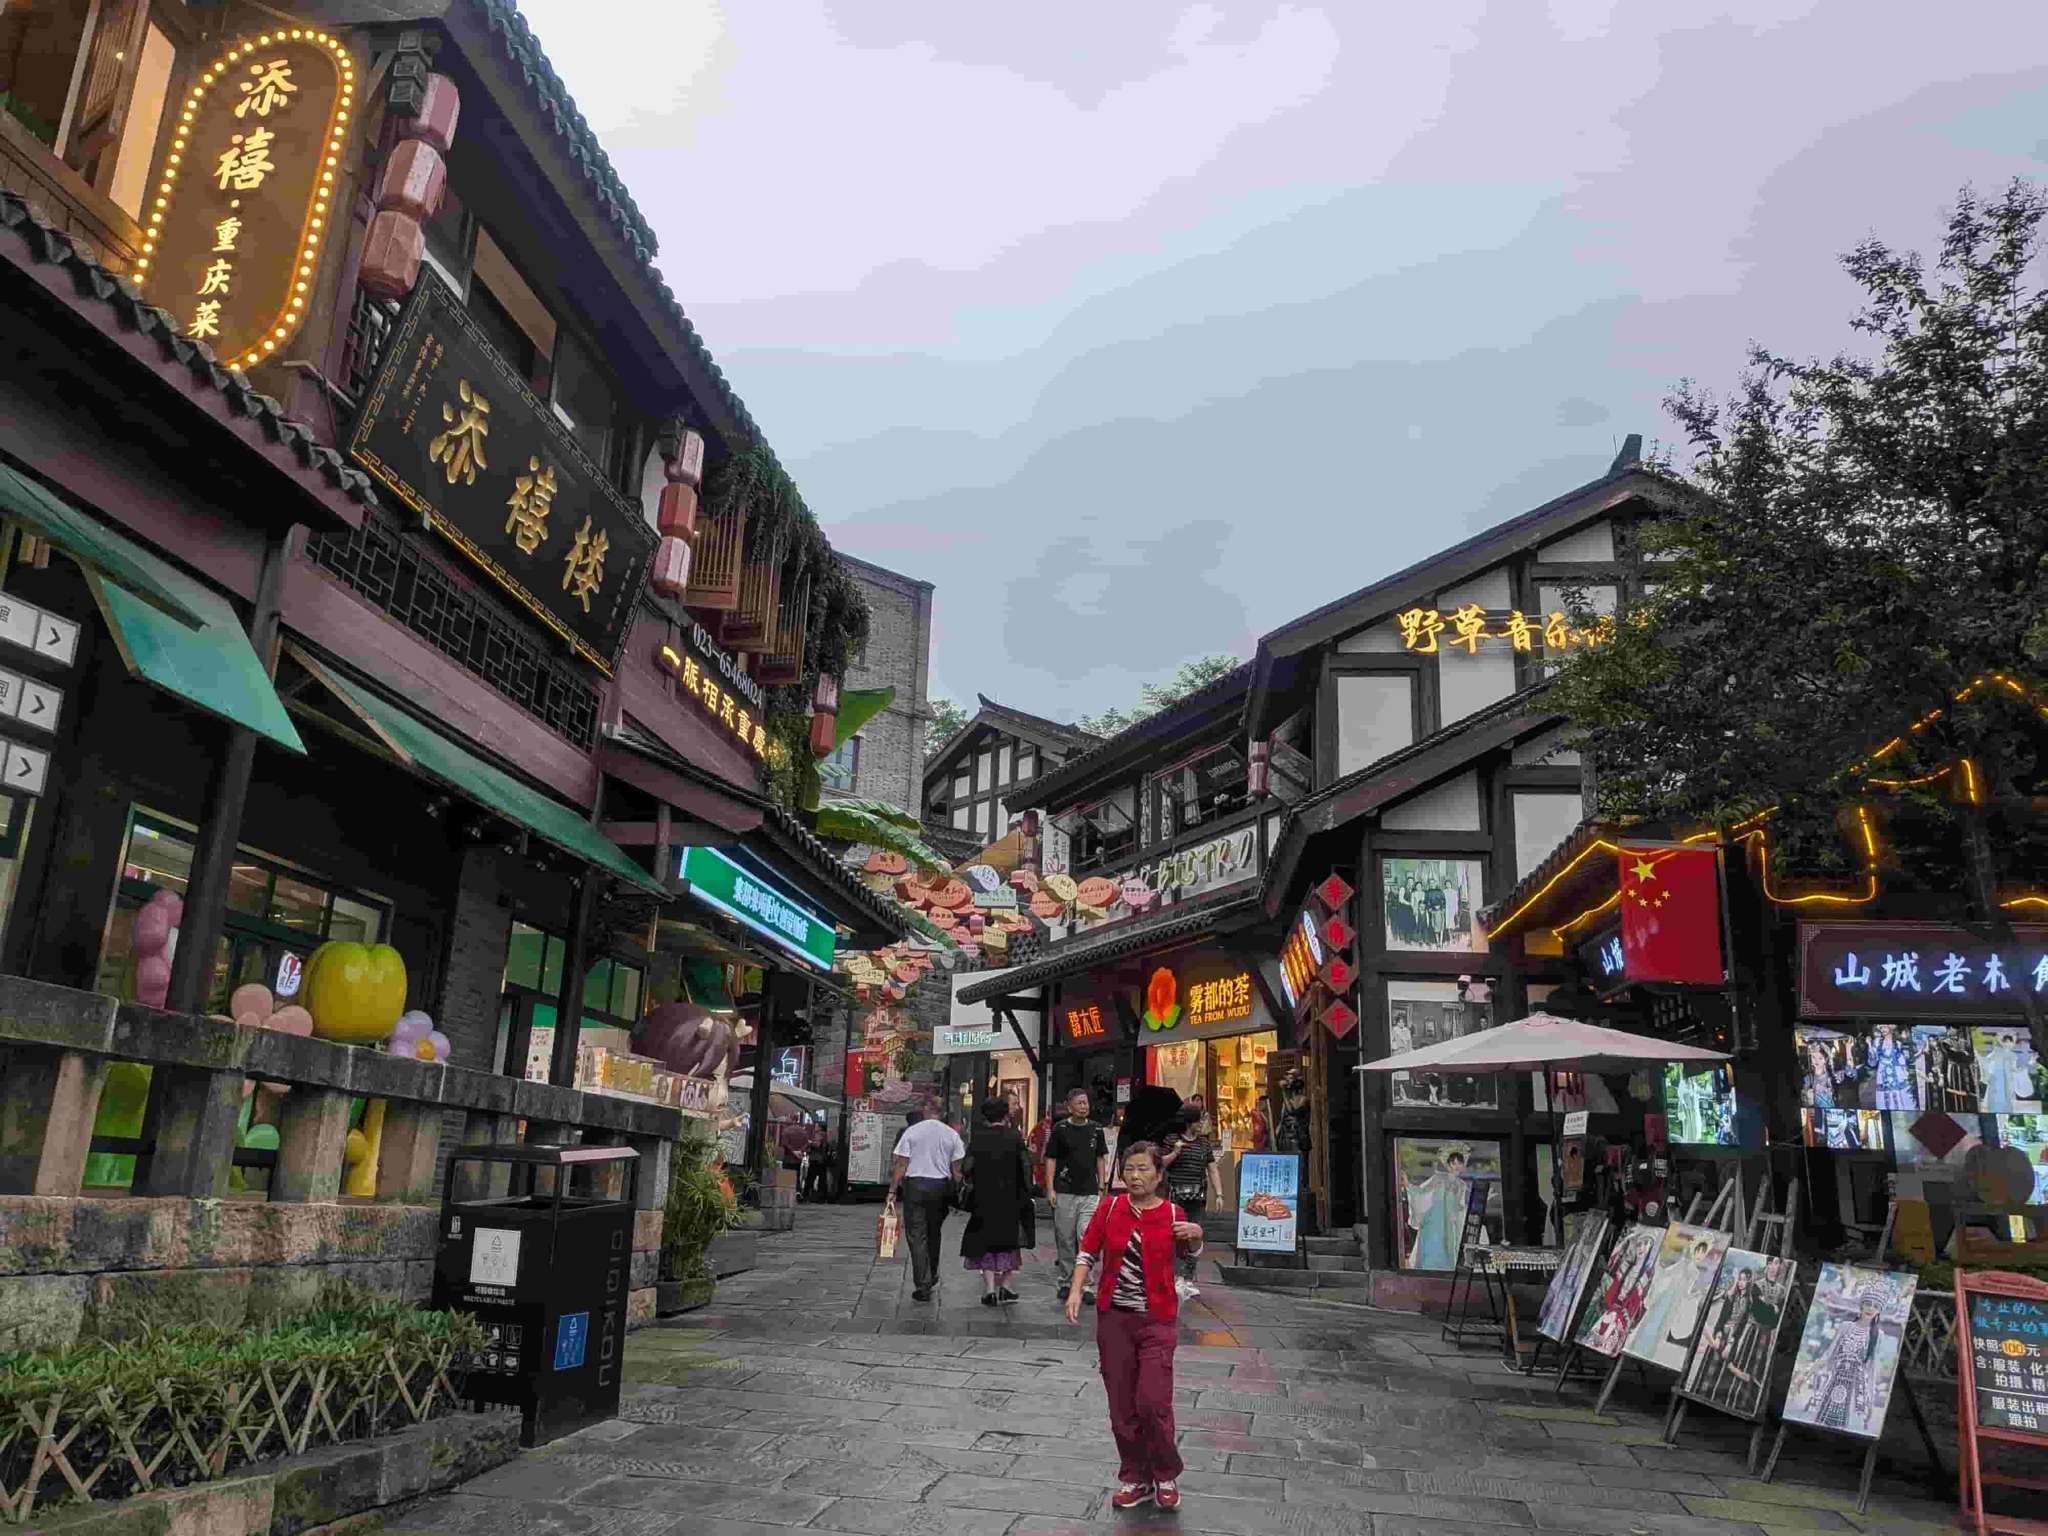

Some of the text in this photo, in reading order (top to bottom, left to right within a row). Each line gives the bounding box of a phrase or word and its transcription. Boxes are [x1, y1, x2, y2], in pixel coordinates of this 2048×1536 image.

[693, 622, 764, 709] 023-65468024
[1189, 973, 1250, 1014] 雾都的茶
[1190, 1005, 1250, 1025] TEA FROM WUDU
[1976, 1355, 2048, 1377] 含:服装、化
